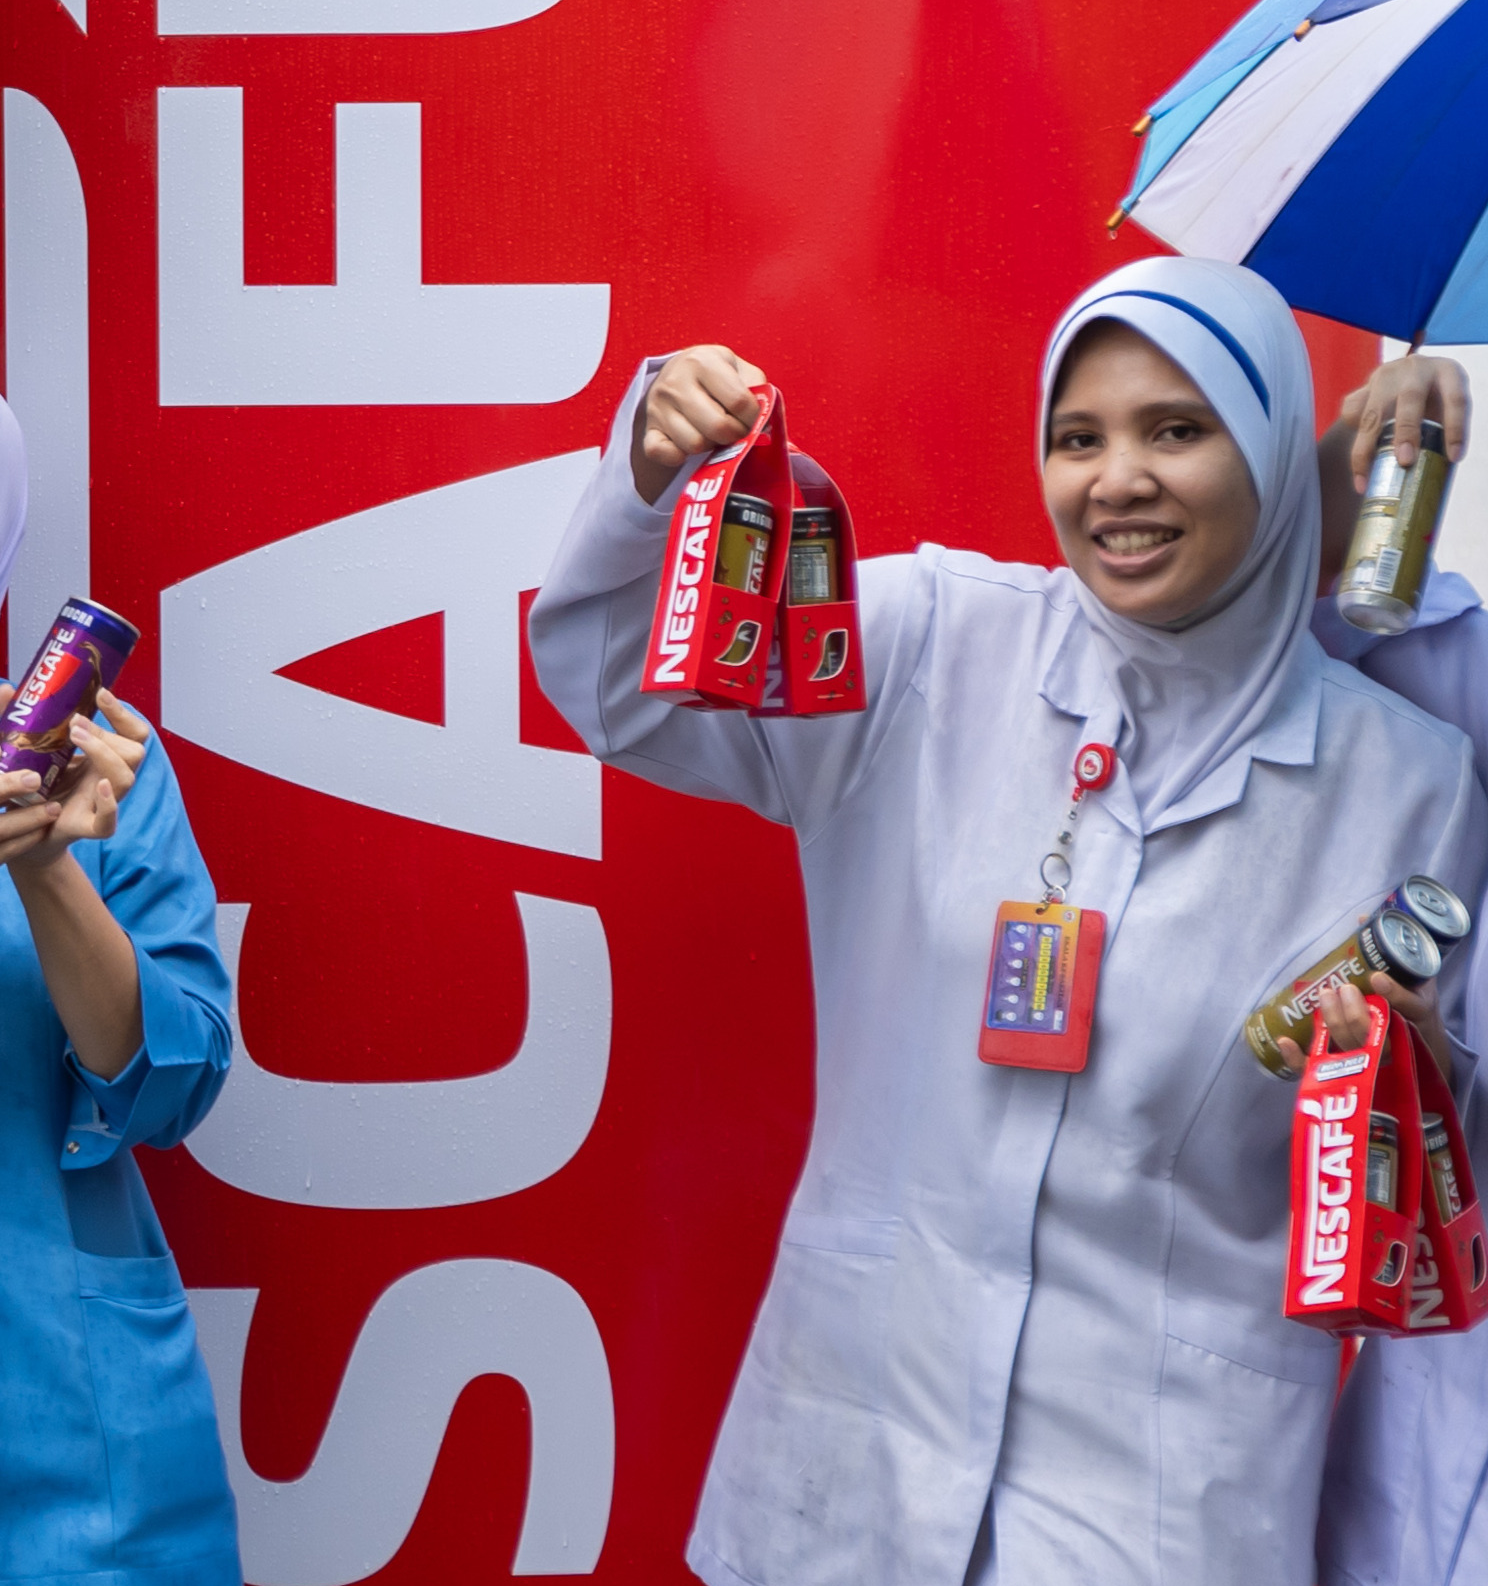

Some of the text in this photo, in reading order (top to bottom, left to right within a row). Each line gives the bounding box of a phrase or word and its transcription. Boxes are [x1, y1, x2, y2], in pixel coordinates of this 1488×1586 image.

[7, 626, 77, 726] NESCAFÉ
[654, 470, 726, 684] NESCAFÉ
[1297, 1085, 1359, 1306] NESCAFÉ
